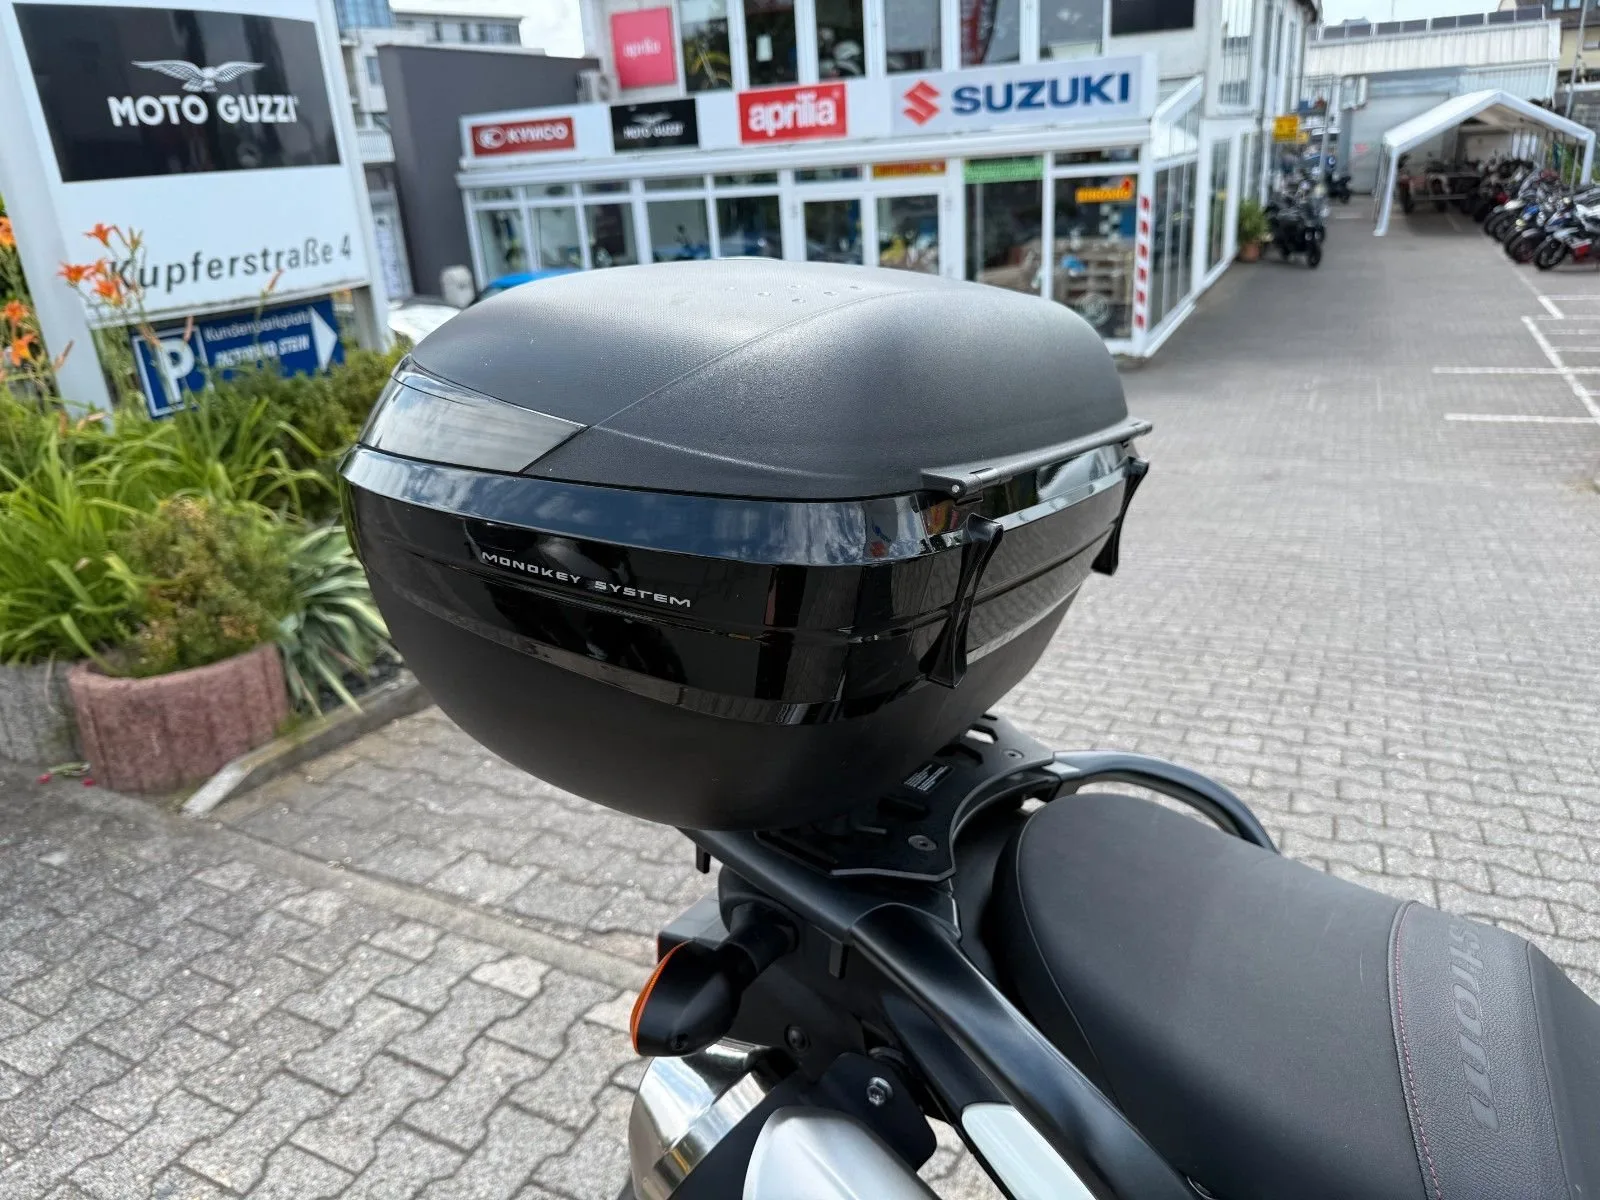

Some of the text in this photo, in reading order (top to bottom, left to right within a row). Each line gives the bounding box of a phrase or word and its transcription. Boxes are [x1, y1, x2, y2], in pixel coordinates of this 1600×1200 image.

[107, 94, 298, 127] MOTO GUZZI
[748, 91, 837, 137] aprilia
[952, 72, 1131, 115] SUZUKI
[507, 122, 569, 146] KYMCO
[622, 126, 651, 140] MOTO
[110, 235, 352, 292] Kupferstraße 4
[481, 551, 691, 607] MONOKEY SYSTEM
